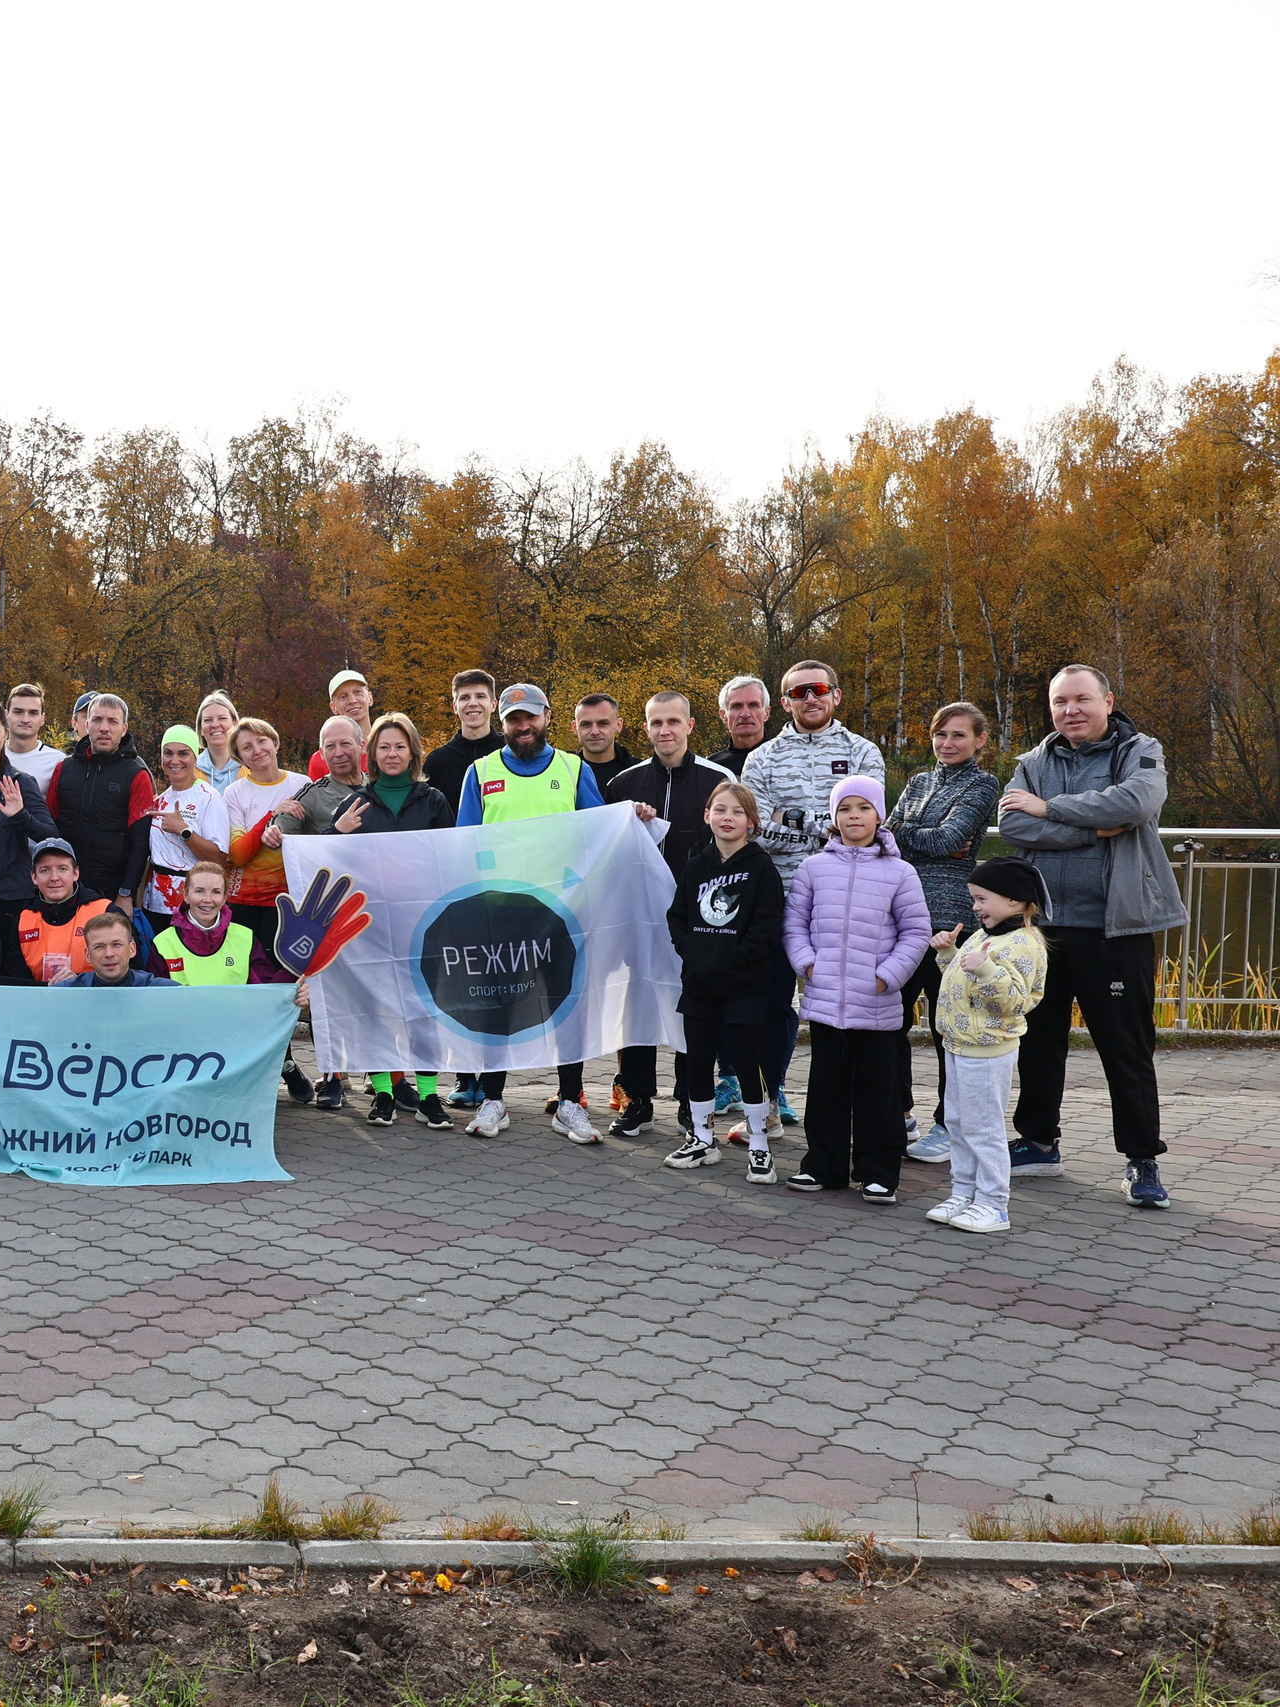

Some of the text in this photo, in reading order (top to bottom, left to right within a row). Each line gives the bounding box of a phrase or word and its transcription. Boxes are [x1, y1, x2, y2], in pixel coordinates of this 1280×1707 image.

[697, 872, 749, 903] DAYLIFE
[693, 926, 715, 934] DAYLIFE
[442, 937, 552, 976] РЕЖИМ
[105, 1112, 252, 1148] НОВГОРОД
[148, 1150, 193, 1168] ПАРК
